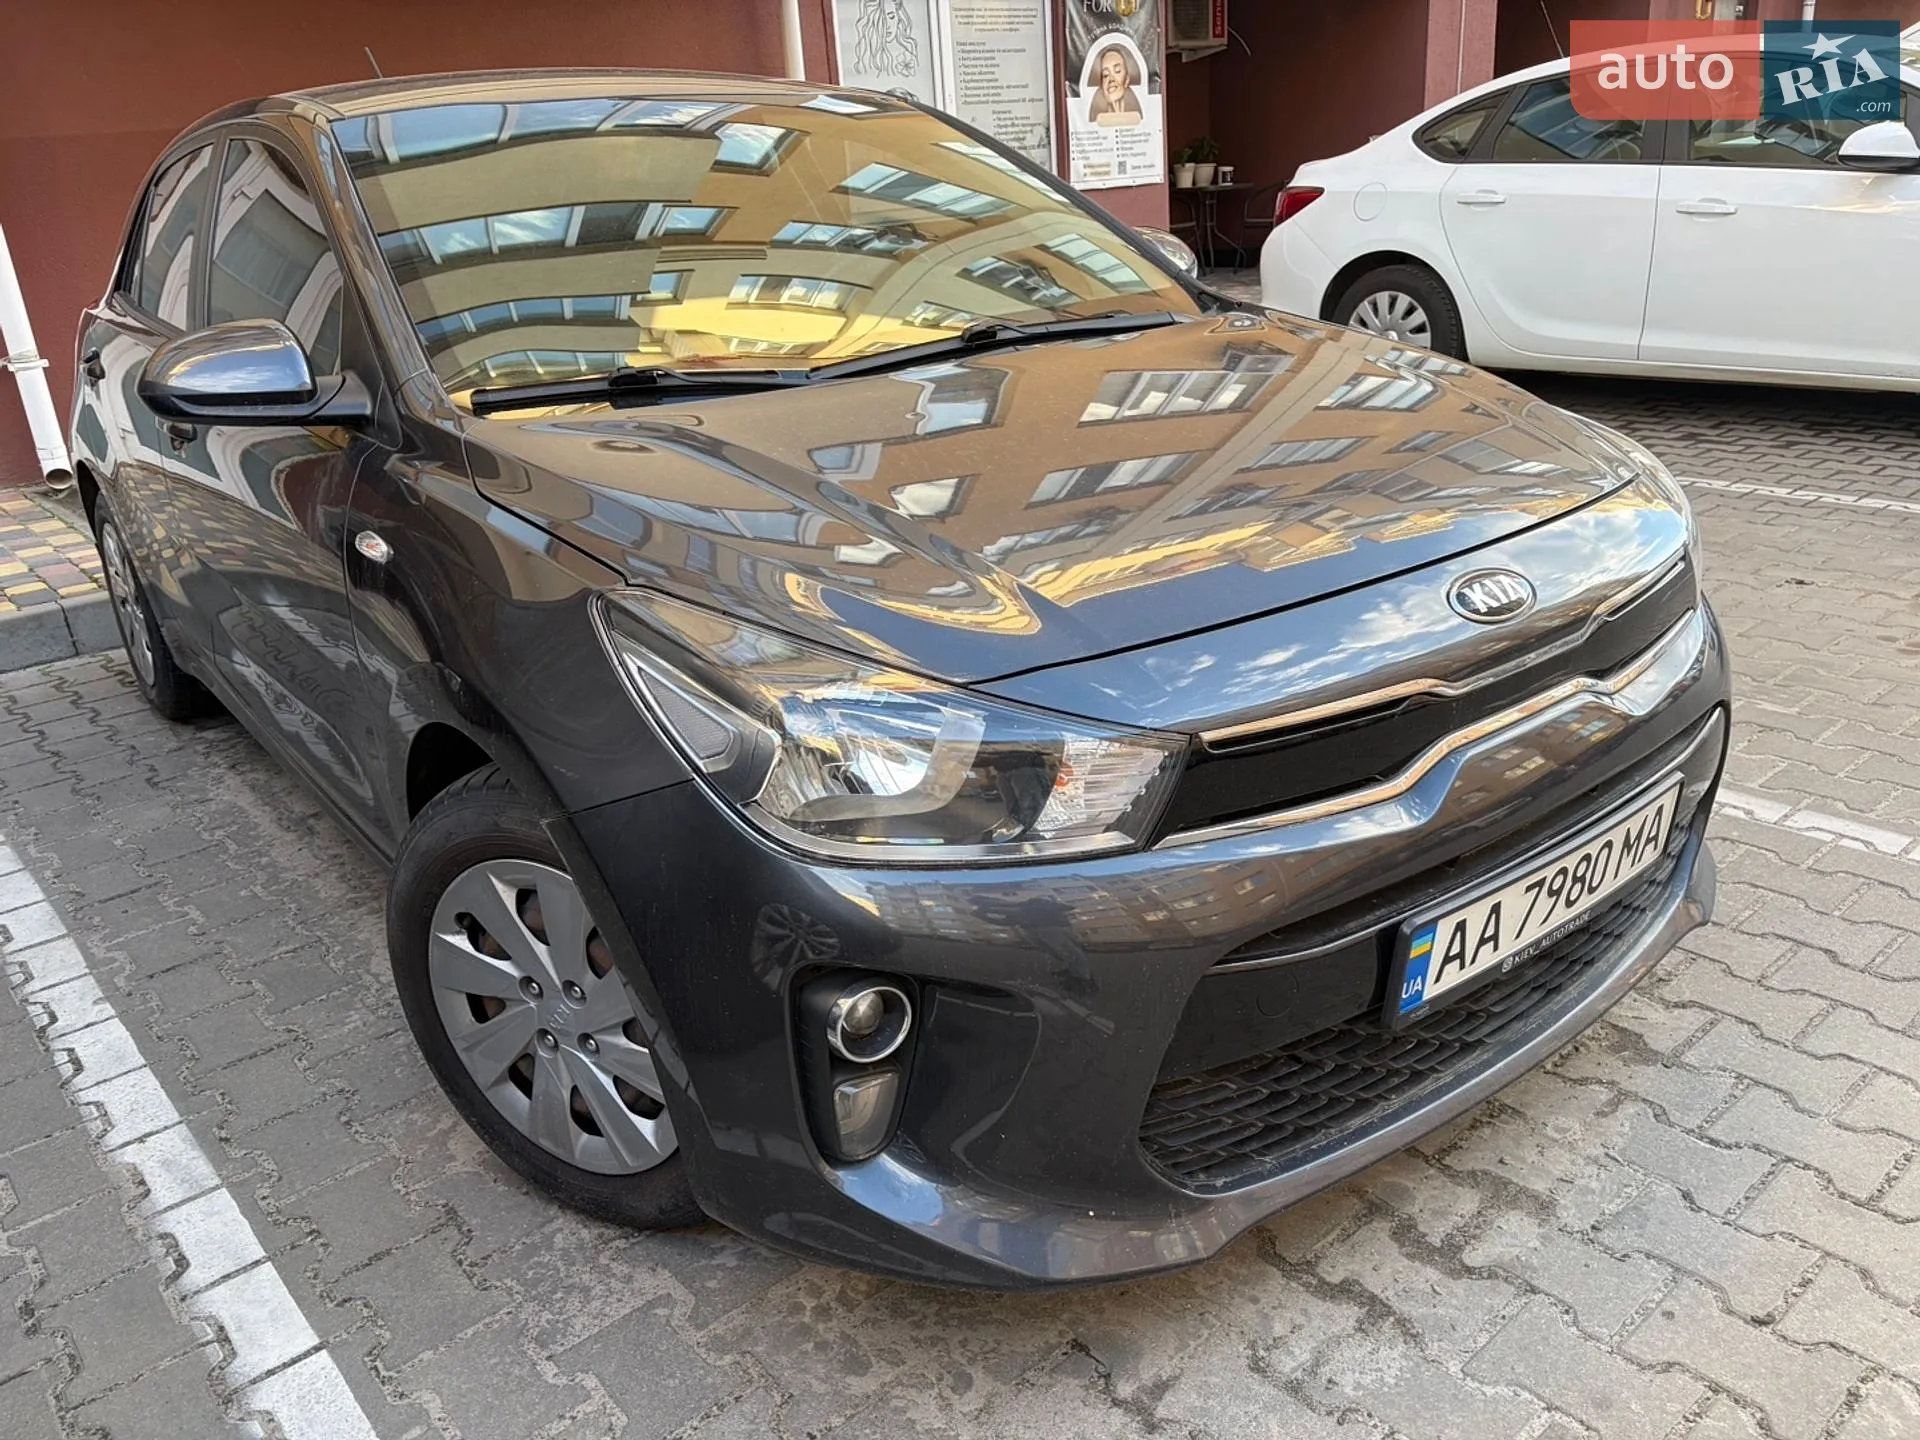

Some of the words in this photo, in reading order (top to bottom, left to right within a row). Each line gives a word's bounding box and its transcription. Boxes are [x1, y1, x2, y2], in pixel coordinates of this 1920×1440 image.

[1459, 574, 1529, 613] KIA
[1433, 900, 1502, 985] AA
[1514, 839, 1613, 941] 7980
[1613, 804, 1665, 881] MA
[1401, 975, 1423, 999] UA
